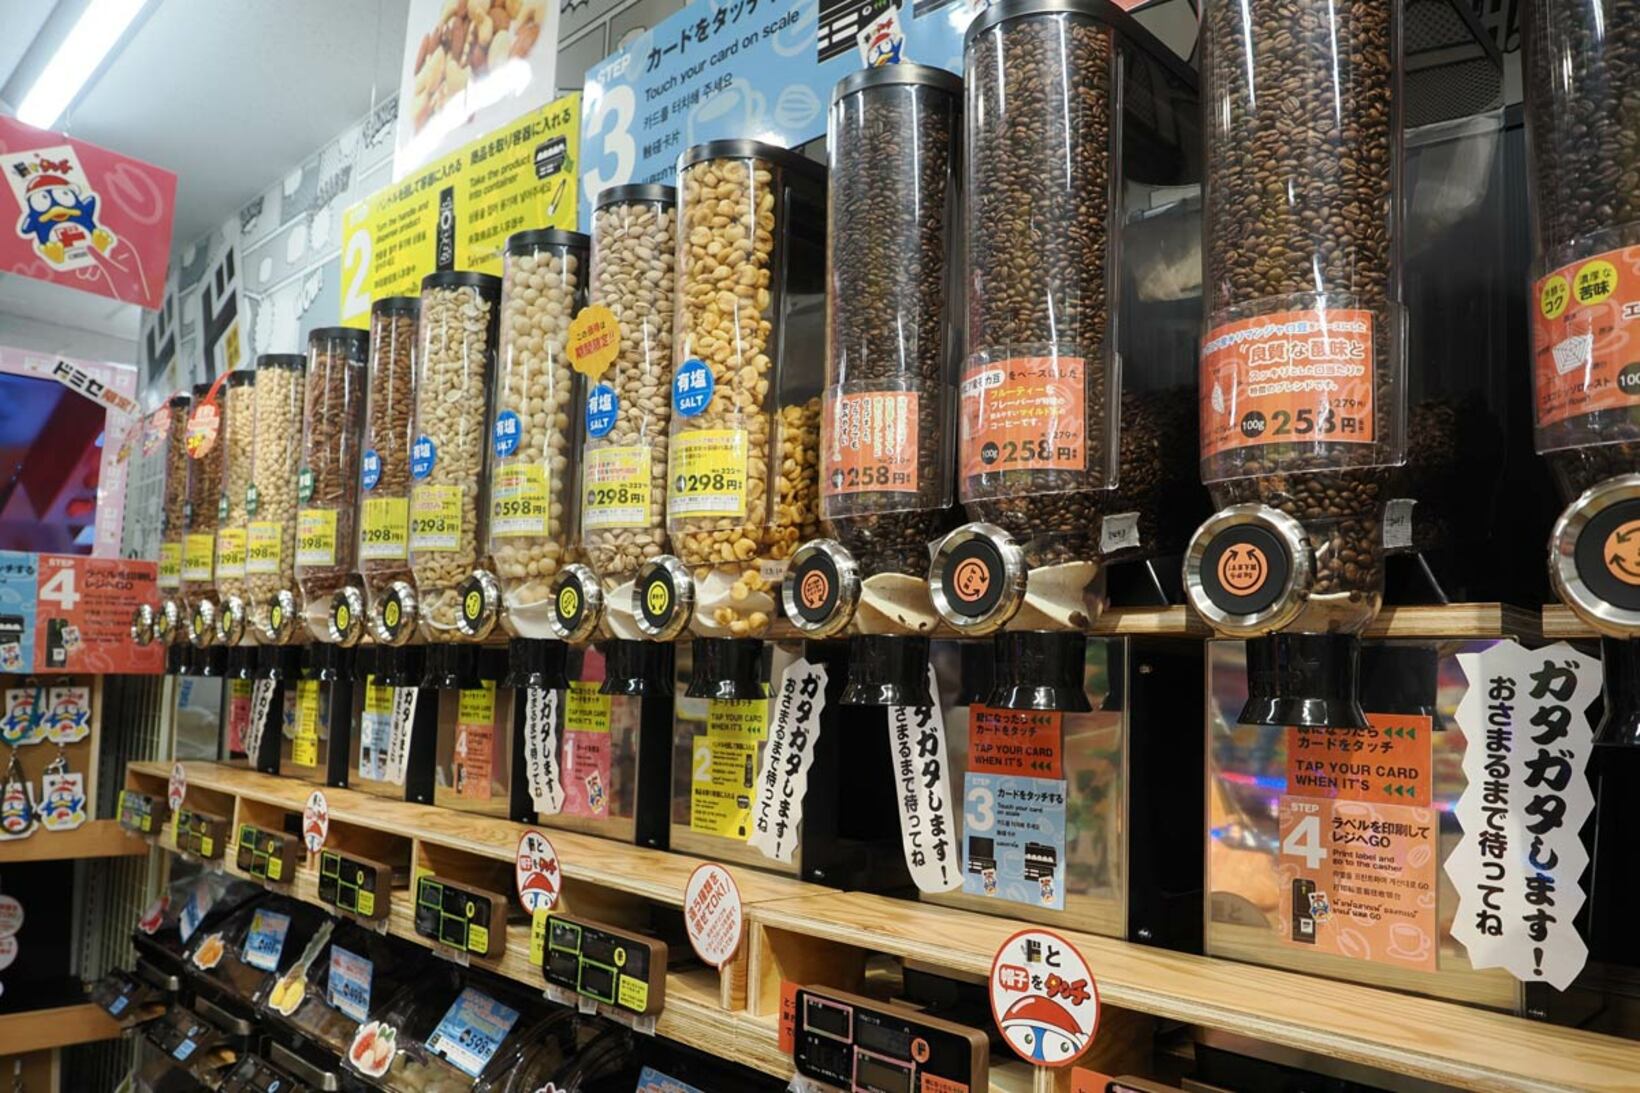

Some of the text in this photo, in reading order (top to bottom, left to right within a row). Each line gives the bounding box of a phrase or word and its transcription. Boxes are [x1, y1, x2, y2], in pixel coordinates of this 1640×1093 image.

[646, 0, 777, 73] カードをタッチ
[645, 10, 800, 102] Touch your card on scale
[599, 54, 631, 84] STEP
[583, 86, 636, 205] 3
[501, 154, 531, 174] product
[345, 230, 372, 319] 2
[1579, 282, 1610, 301] 苦味
[1545, 296, 1563, 314] コク
[677, 369, 707, 393] 有塩
[589, 393, 612, 414] 有塩
[680, 395, 704, 410] SALT
[590, 418, 609, 430] SALT
[1242, 419, 1264, 432] 100g
[39, 568, 81, 611] 4
[745, 714, 763, 723] CARD
[976, 724, 1037, 737] カードをタッチ
[455, 730, 468, 758] 4
[975, 743, 1053, 757] TAP YOUR CARD
[1297, 737, 1394, 754] カードをタッチ
[694, 746, 712, 781] 2
[757, 678, 796, 833] おさまるまで待ってね
[975, 755, 1023, 768] WHEN IT'S
[1295, 760, 1419, 780] TAP YOUR CARD
[1295, 775, 1370, 792] WHEN IT'S
[998, 788, 1064, 804] カードをタッチする
[966, 787, 995, 832] 3
[1290, 802, 1320, 814] STEP
[1475, 676, 1517, 937] おさまるまで待ってね
[1332, 817, 1430, 840] ラベルを印刷して
[1523, 660, 1580, 977] ガタガタします!
[1281, 816, 1327, 870] 4
[1333, 832, 1391, 848] レジへGO
[1333, 849, 1395, 864] Print label and
[1333, 859, 1343, 867] go
[1357, 860, 1370, 868] the
